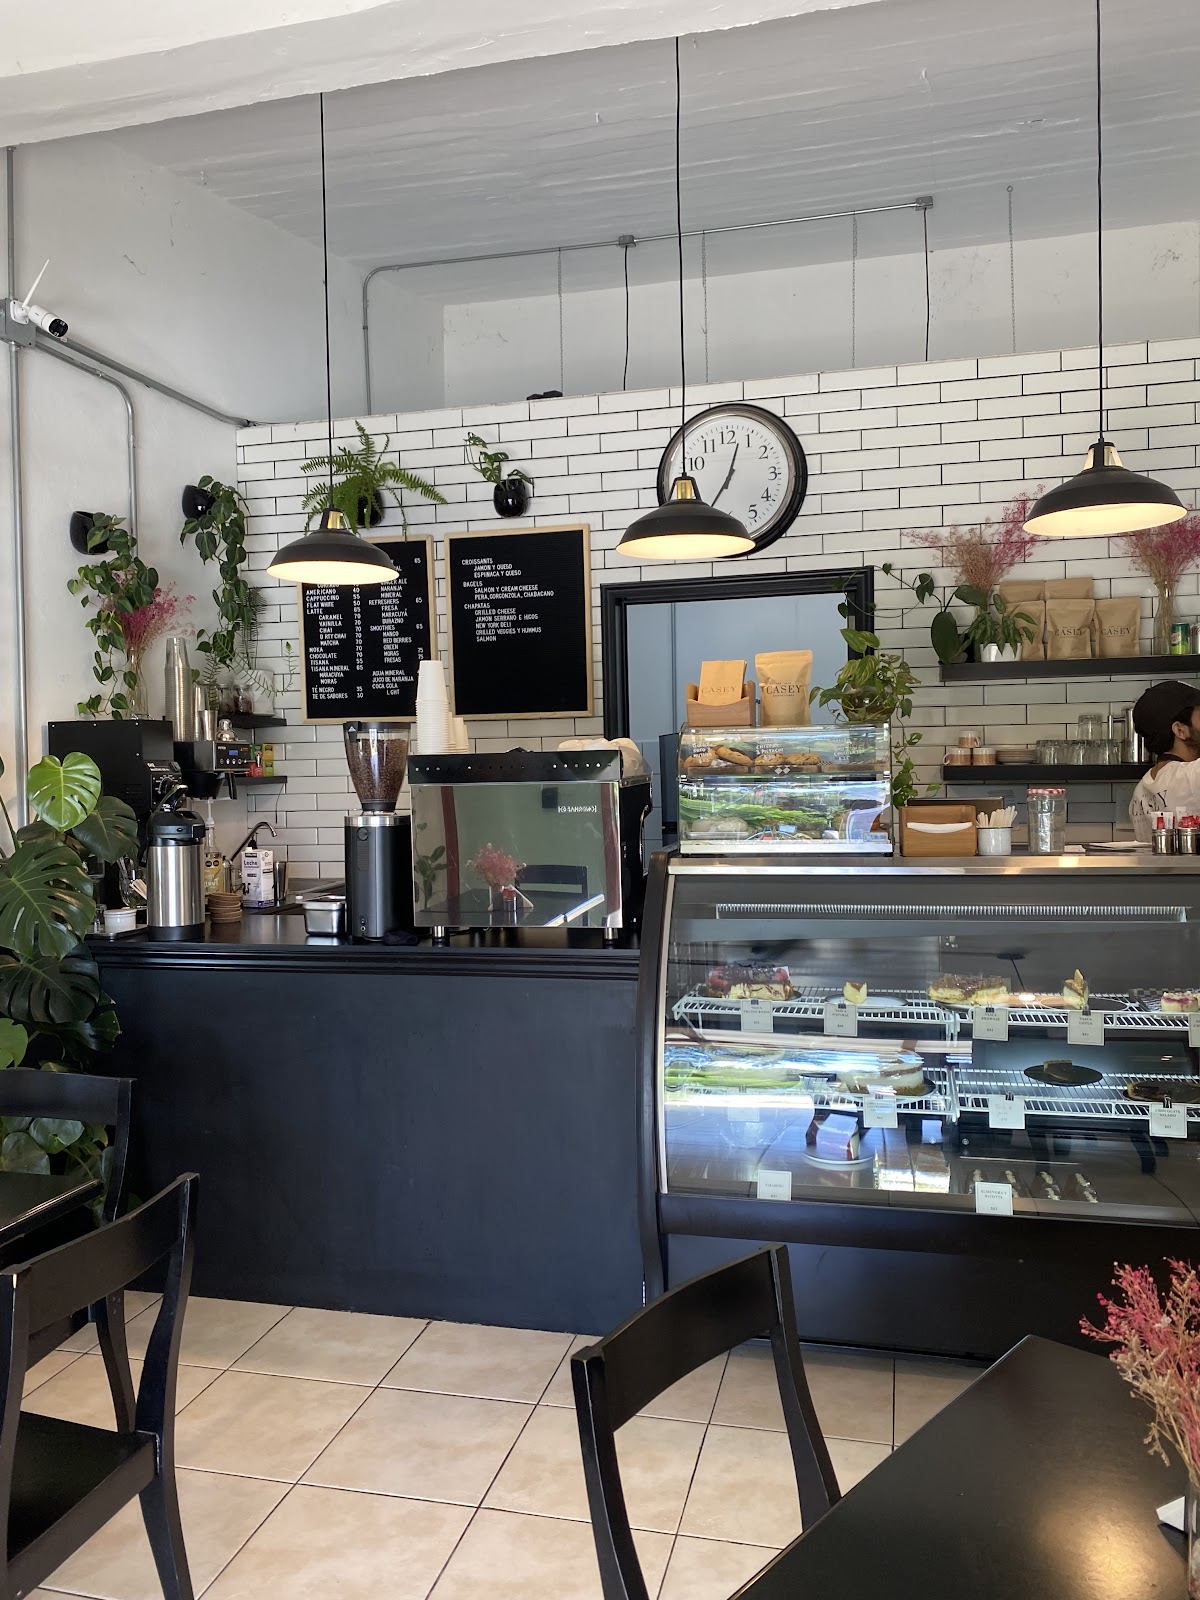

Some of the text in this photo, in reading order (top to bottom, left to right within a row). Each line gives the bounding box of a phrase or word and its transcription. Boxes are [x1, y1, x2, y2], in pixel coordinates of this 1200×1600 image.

[719, 430, 736, 445] 12
[745, 433, 752, 448] 1
[703, 439, 717, 453] 11
[758, 445, 768, 459] 2
[688, 456, 705, 471] 10
[768, 466, 777, 481] 3
[761, 487, 771, 502] 4
[748, 504, 758, 519] 5
[523, 590, 554, 598] CHABACANO
[1100, 628, 1131, 636] CASEY
[766, 685, 802, 694] CASEY
